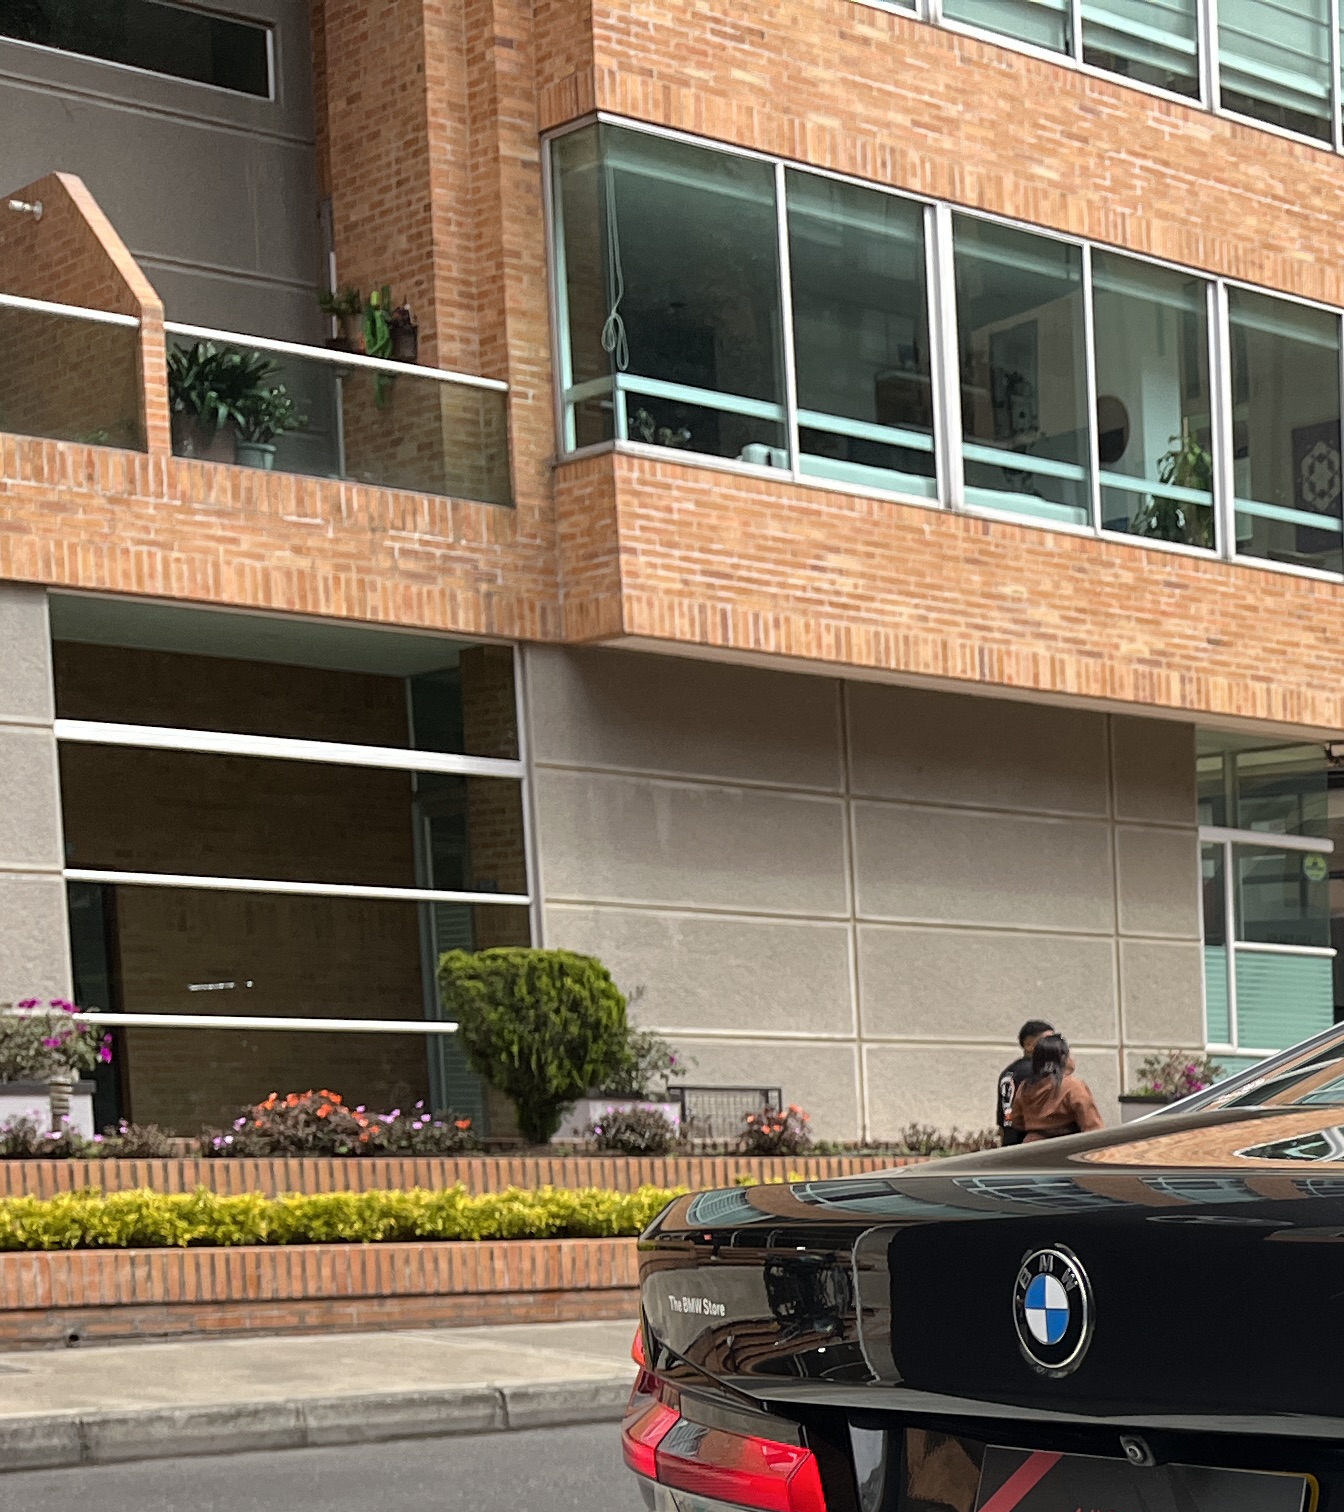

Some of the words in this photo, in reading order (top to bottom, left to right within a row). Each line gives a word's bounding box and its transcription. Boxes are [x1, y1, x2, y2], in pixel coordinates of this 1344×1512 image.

[1019, 1254, 1078, 1292] BMW
[668, 1295, 683, 1313] The
[682, 1296, 702, 1314] BMW
[702, 1297, 726, 1317] Store
